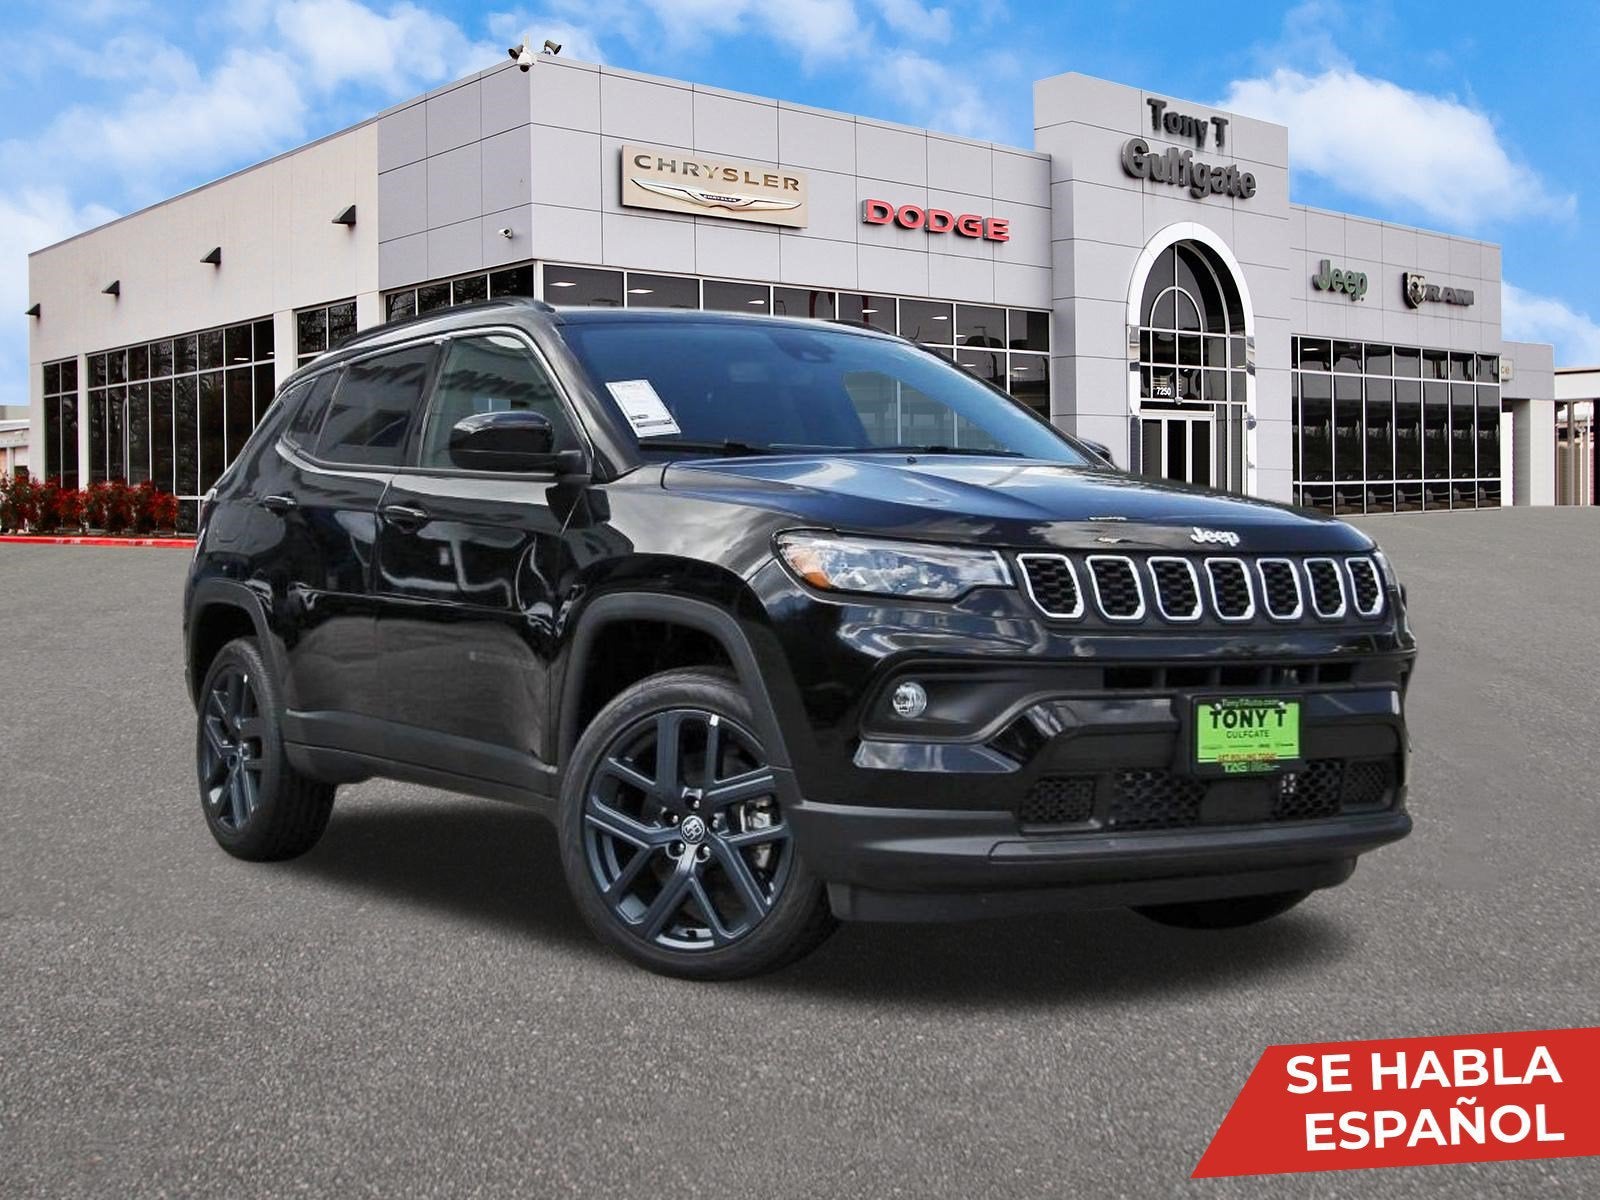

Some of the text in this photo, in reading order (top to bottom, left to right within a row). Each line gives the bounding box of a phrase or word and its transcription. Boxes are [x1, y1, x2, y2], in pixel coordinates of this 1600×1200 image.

[1147, 98, 1229, 147] Tony T
[633, 154, 800, 192] CHRYSLER
[1121, 138, 1256, 199] Gulfgate
[863, 199, 1010, 242] DODGE
[1312, 259, 1368, 301] Jeep
[1425, 284, 1474, 307] RAM
[1190, 526, 1240, 547] Jeep
[1209, 709, 1287, 729] TONY T
